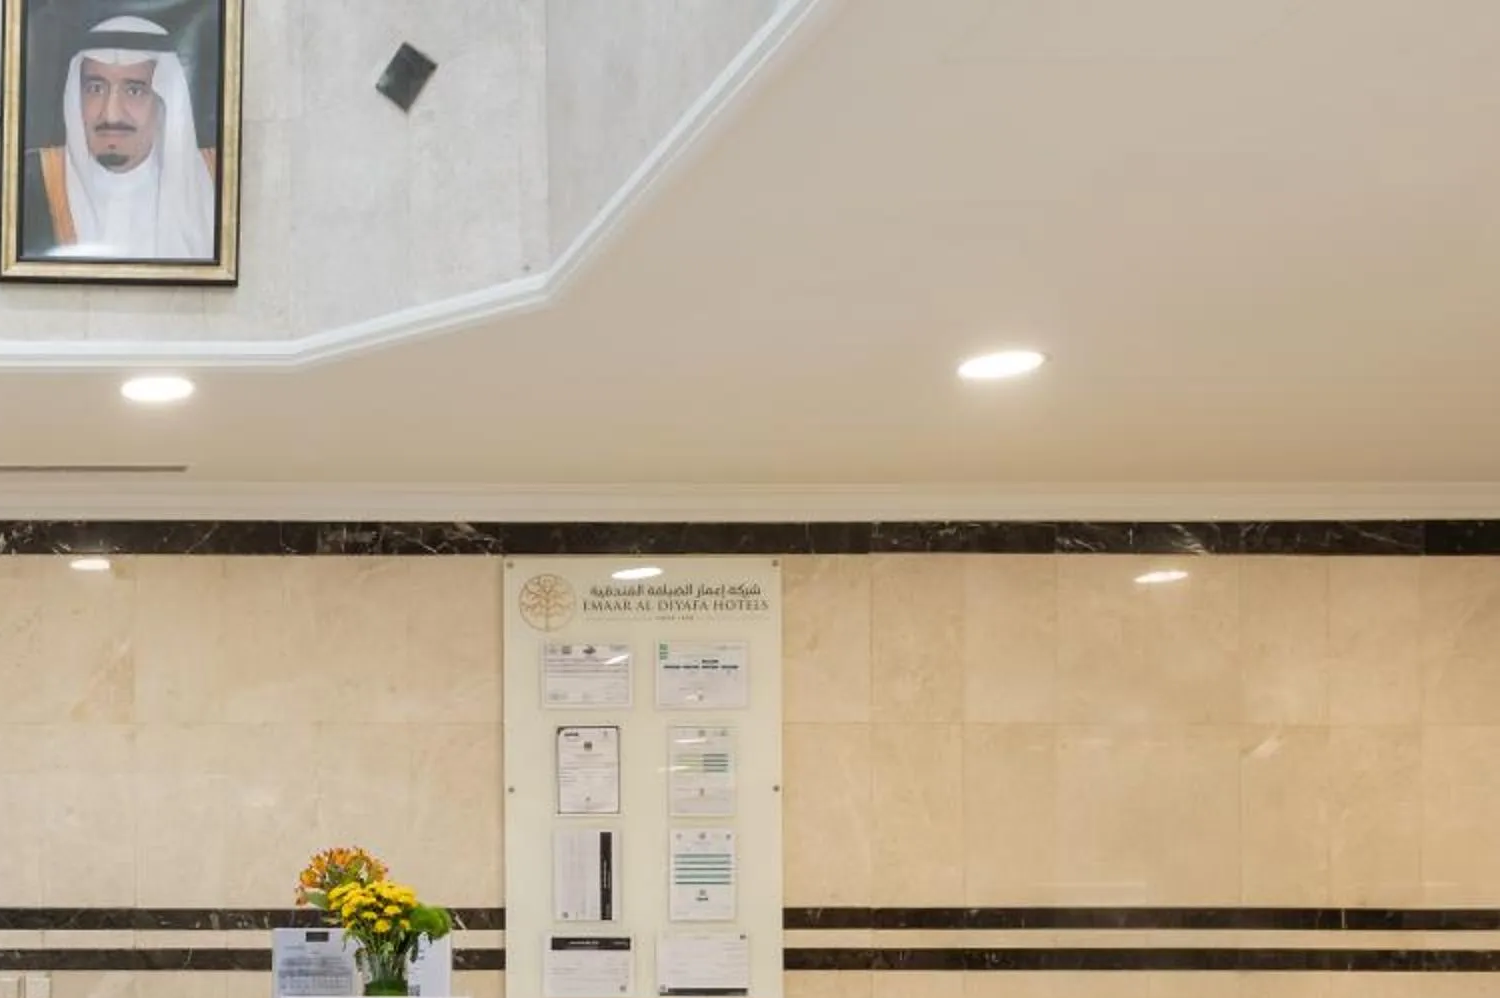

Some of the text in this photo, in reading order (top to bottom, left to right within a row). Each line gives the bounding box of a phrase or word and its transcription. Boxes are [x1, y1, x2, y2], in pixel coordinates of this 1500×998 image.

[590, 582, 761, 599] شركة إعمار الضيافة الفندقية
[636, 600, 652, 612] AL
